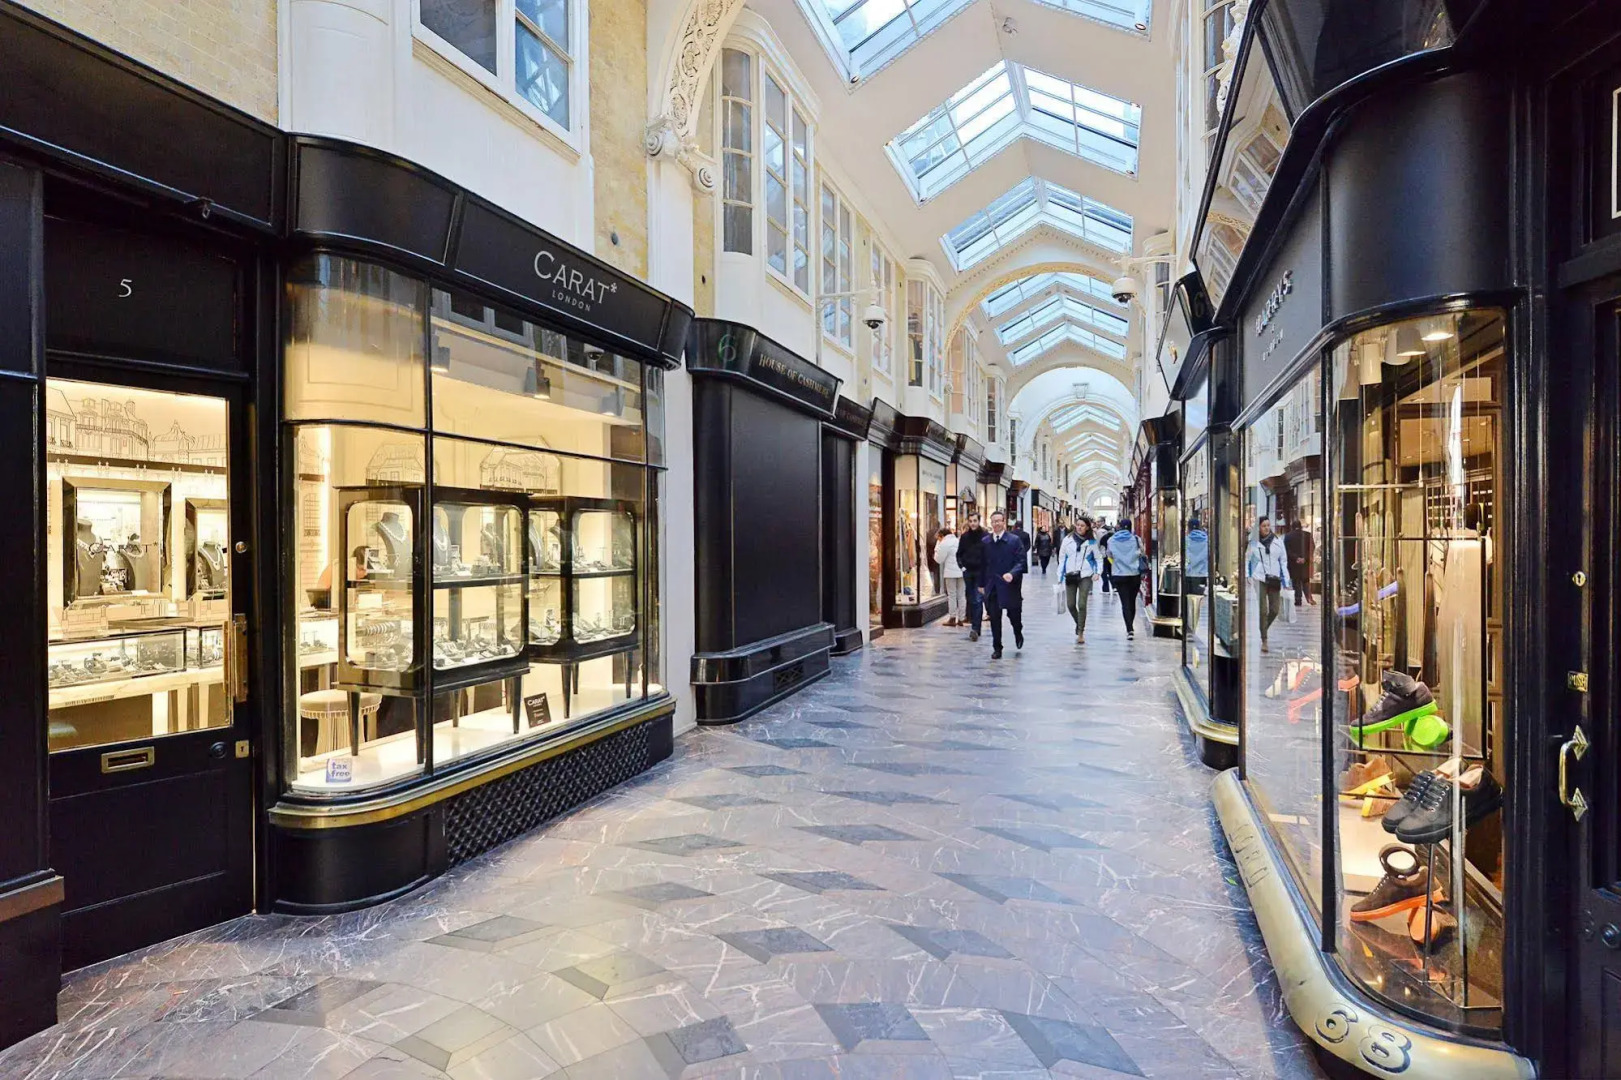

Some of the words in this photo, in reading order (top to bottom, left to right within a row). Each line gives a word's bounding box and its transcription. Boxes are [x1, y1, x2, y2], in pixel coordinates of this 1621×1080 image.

[118, 278, 132, 297] 5
[551, 289, 591, 311] LONDON
[718, 333, 736, 362] 6
[758, 353, 786, 375] HOUSE
[787, 368, 798, 380] OF
[331, 761, 348, 770] tax
[331, 769, 351, 778] free
[1314, 1002, 1413, 1074] 68
